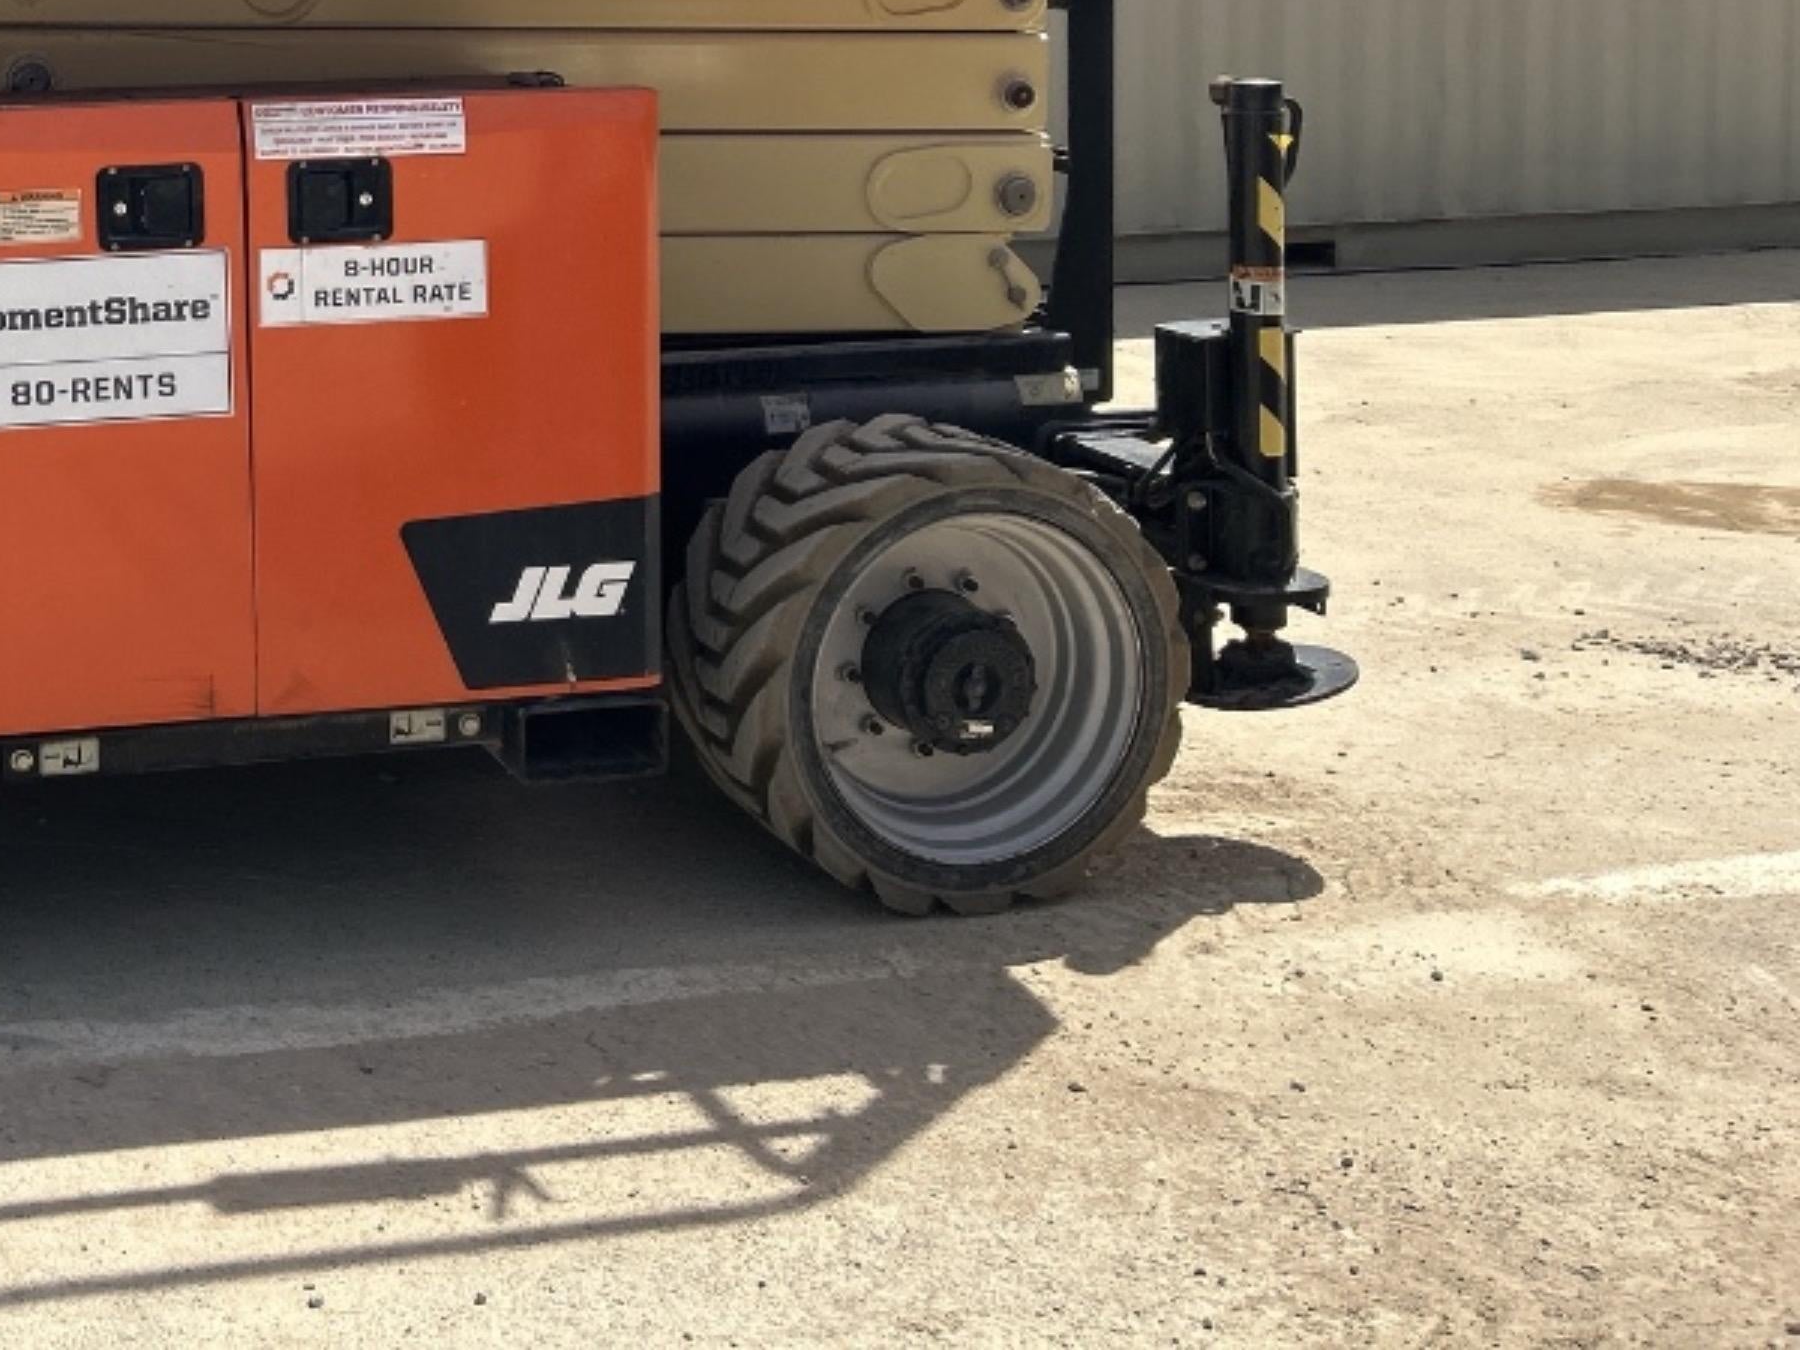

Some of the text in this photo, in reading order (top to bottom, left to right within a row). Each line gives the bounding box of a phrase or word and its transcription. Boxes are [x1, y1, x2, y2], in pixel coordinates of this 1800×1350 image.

[344, 257, 433, 277] 8-HOUR
[313, 281, 472, 307] RENTAL RATE
[11, 372, 177, 407] 80-RENTS
[489, 561, 637, 624] JLG
